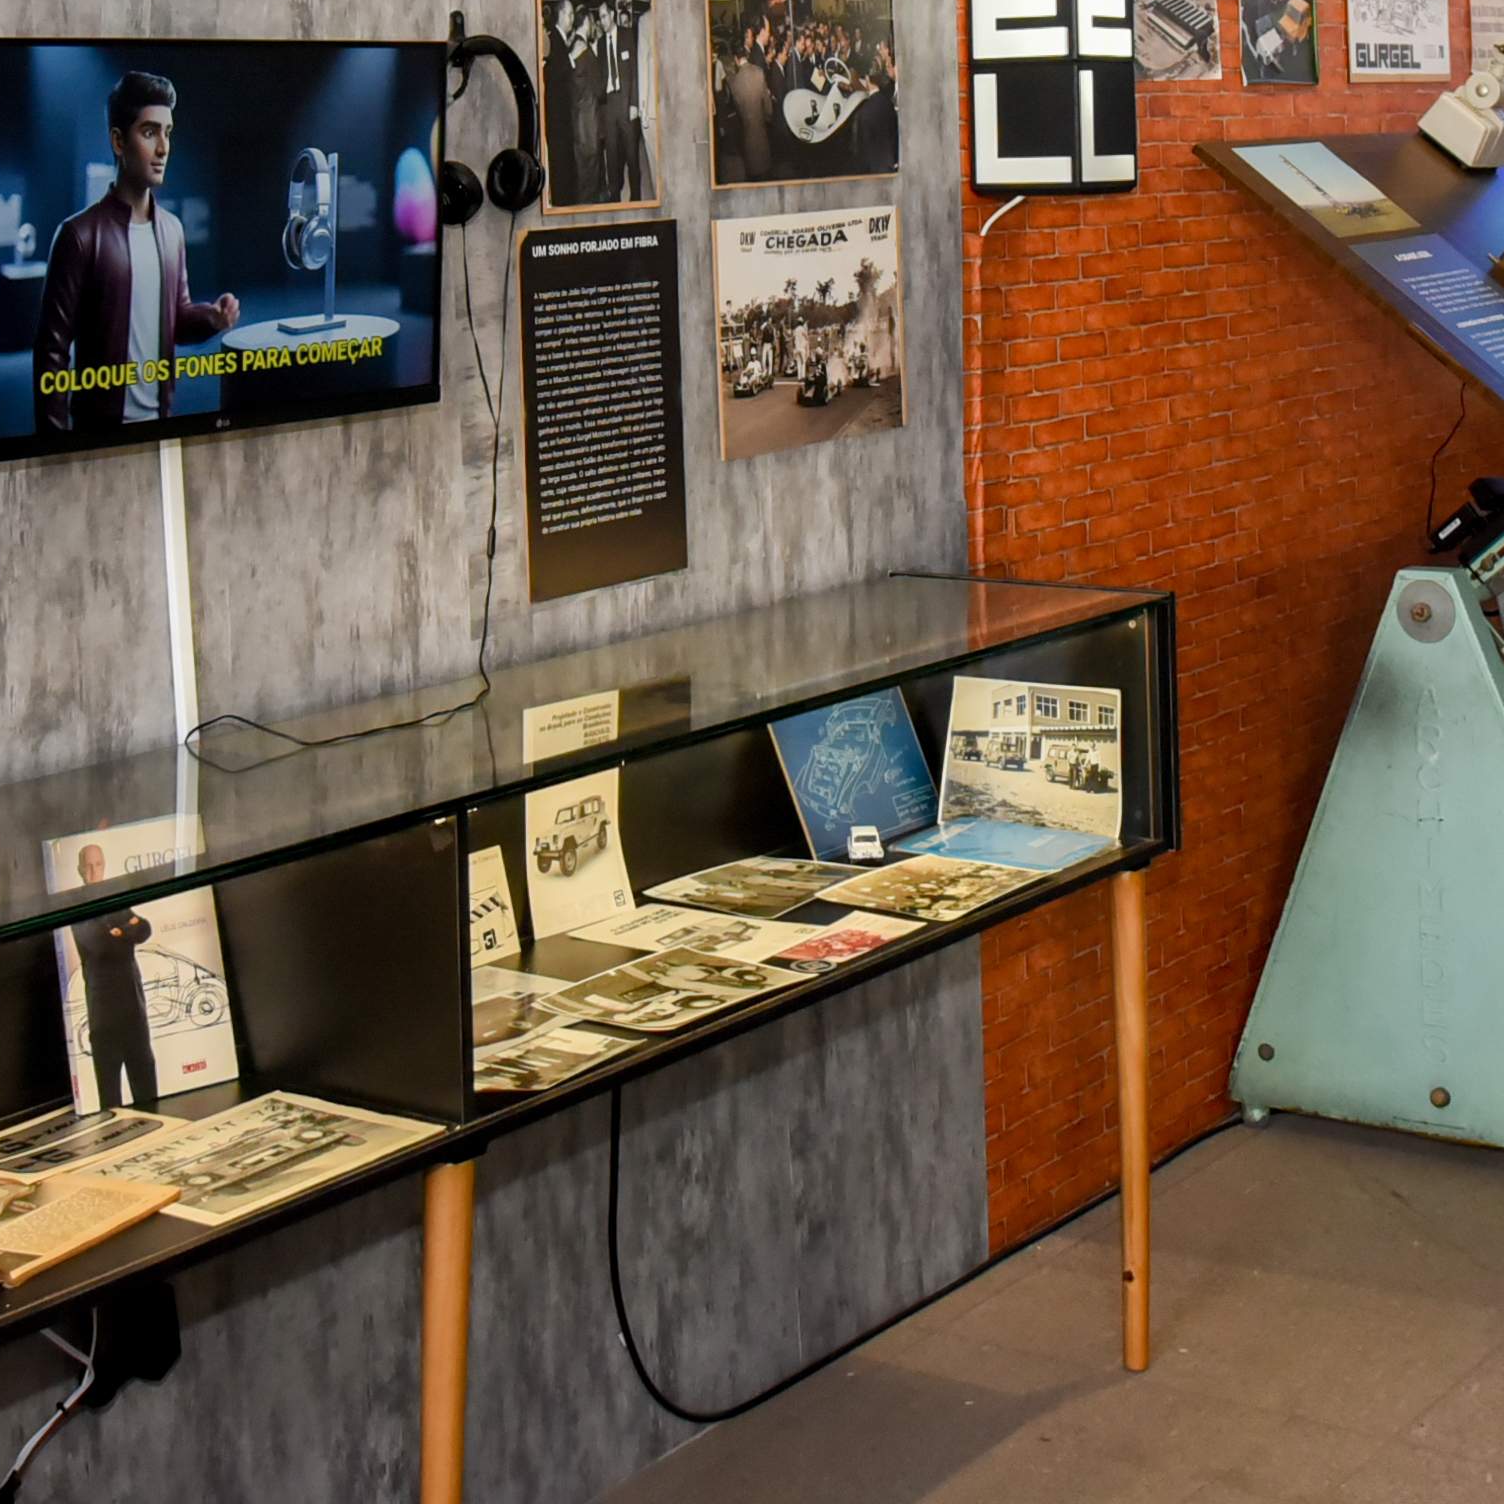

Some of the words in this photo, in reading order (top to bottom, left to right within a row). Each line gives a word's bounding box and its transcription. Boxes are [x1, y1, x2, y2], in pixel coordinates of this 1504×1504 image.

[1356, 43, 1421, 69] GURGEL
[869, 214, 891, 234] DKW
[532, 246, 546, 257] UM
[548, 241, 578, 256] SONHO
[580, 238, 618, 253] FORJADO
[620, 237, 633, 249] EM
[635, 235, 658, 247] FIBRA
[739, 232, 756, 246] DKW
[765, 230, 848, 249] CHEGADA
[40, 362, 137, 395] COLOQUE
[143, 358, 170, 383] OS
[175, 353, 238, 378] FONES
[242, 346, 293, 372] PARA
[296, 336, 382, 366] COMEÇAR
